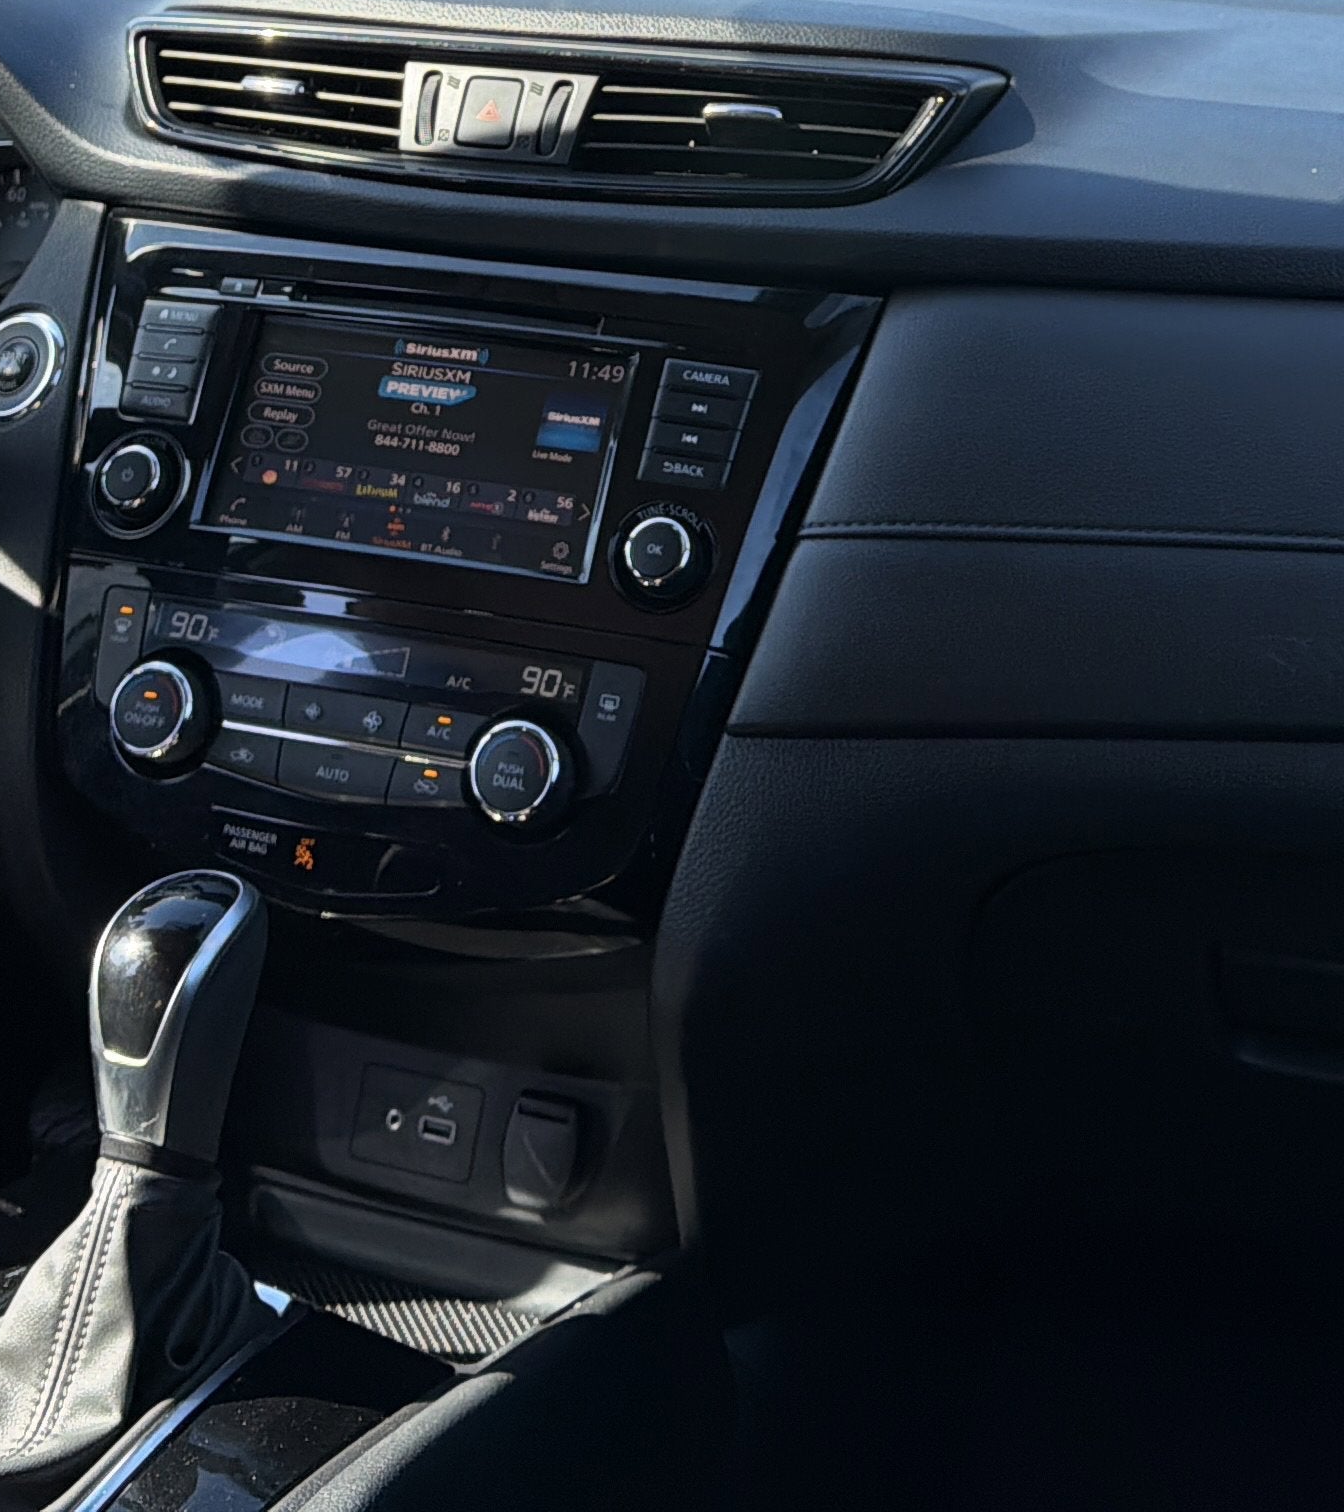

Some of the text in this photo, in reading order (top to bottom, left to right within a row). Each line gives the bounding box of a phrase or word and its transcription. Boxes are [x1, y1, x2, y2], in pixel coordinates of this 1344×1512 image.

[7, 186, 28, 203] 60
[272, 358, 315, 374] Source
[391, 361, 472, 384] SIRIUSXM
[568, 360, 625, 384] 11:49
[682, 369, 730, 386] CAMERA
[259, 382, 316, 399] SXM Menu
[386, 381, 464, 400] PREVIEW
[262, 407, 298, 423] Replay
[410, 402, 441, 416] Ch. 1
[367, 418, 476, 442] Great Offer Now!
[374, 433, 460, 456] 844-711-8800
[284, 459, 299, 472] 11
[335, 465, 353, 479] 57
[674, 463, 704, 478] BACK
[389, 473, 407, 487] 34
[446, 481, 462, 494] 16
[506, 489, 518, 502] 2
[556, 496, 575, 510] 56
[285, 523, 304, 534] AM
[335, 530, 351, 540] FM
[434, 545, 463, 557] Audio
[646, 543, 664, 556] OK
[540, 559, 573, 575] Settings
[445, 675, 472, 691] A/C
[229, 694, 265, 709] MODE
[426, 726, 452, 740] A/C
[315, 765, 350, 783] AUTO
[497, 761, 525, 775] PUSH
[492, 773, 526, 792] DUAL
[222, 822, 278, 845] PASSENGER
[229, 838, 267, 856] AIR BAG
